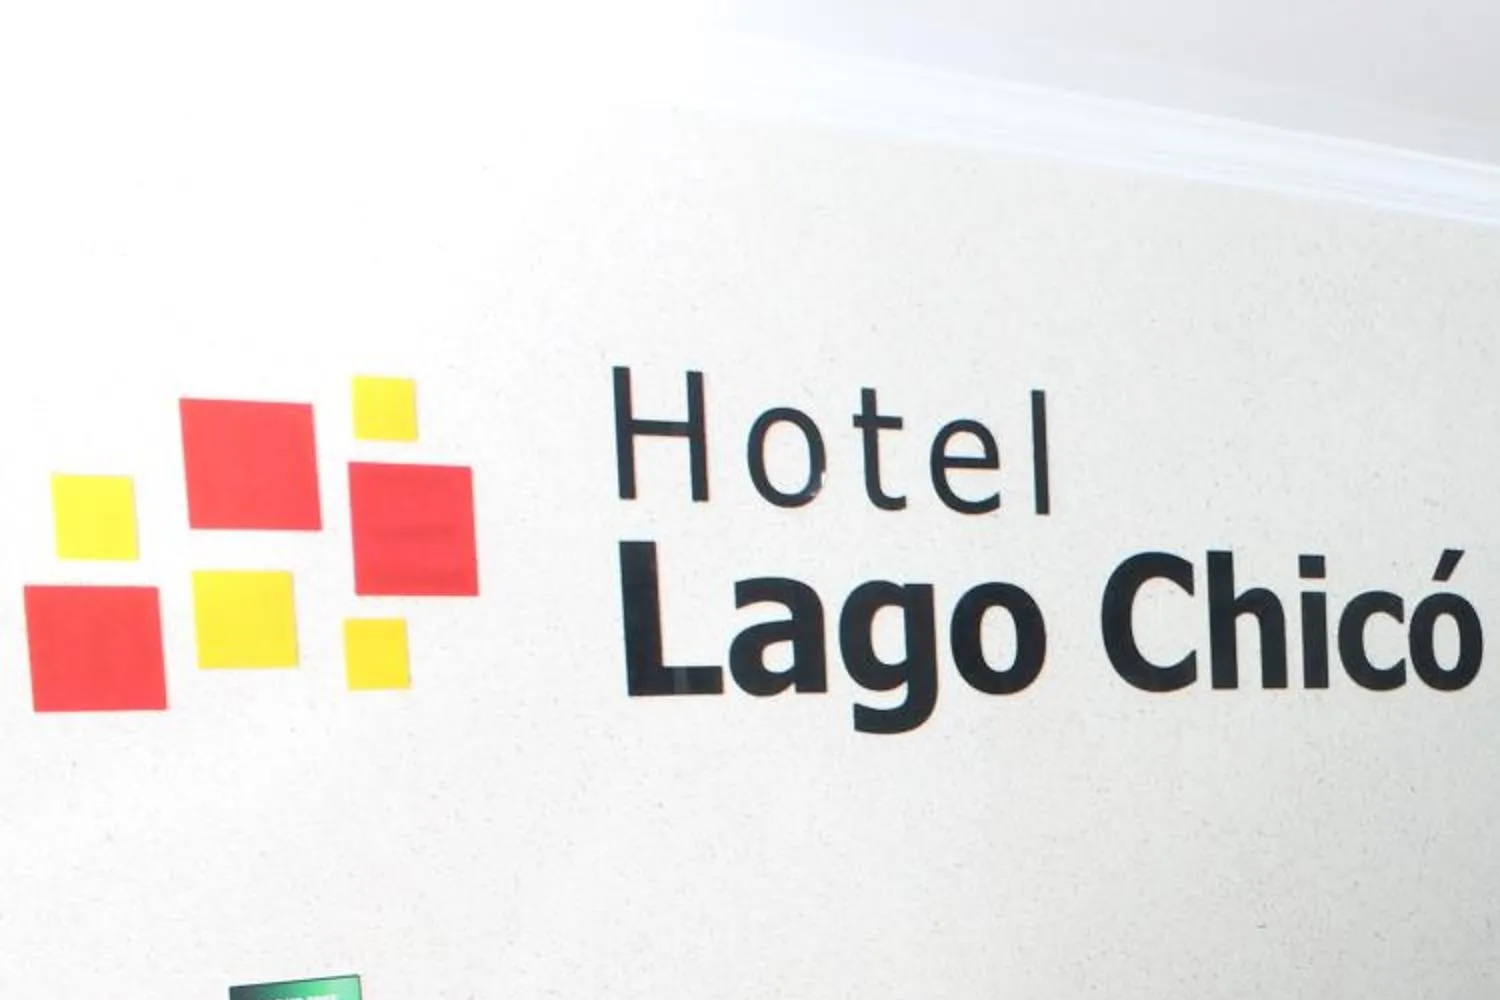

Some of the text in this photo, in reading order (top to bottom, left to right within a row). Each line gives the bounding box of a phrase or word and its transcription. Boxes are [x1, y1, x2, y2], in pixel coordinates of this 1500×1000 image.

[612, 366, 1050, 516] Hotel
[618, 540, 1047, 735] Lago
[1101, 548, 1484, 693] Chicó
